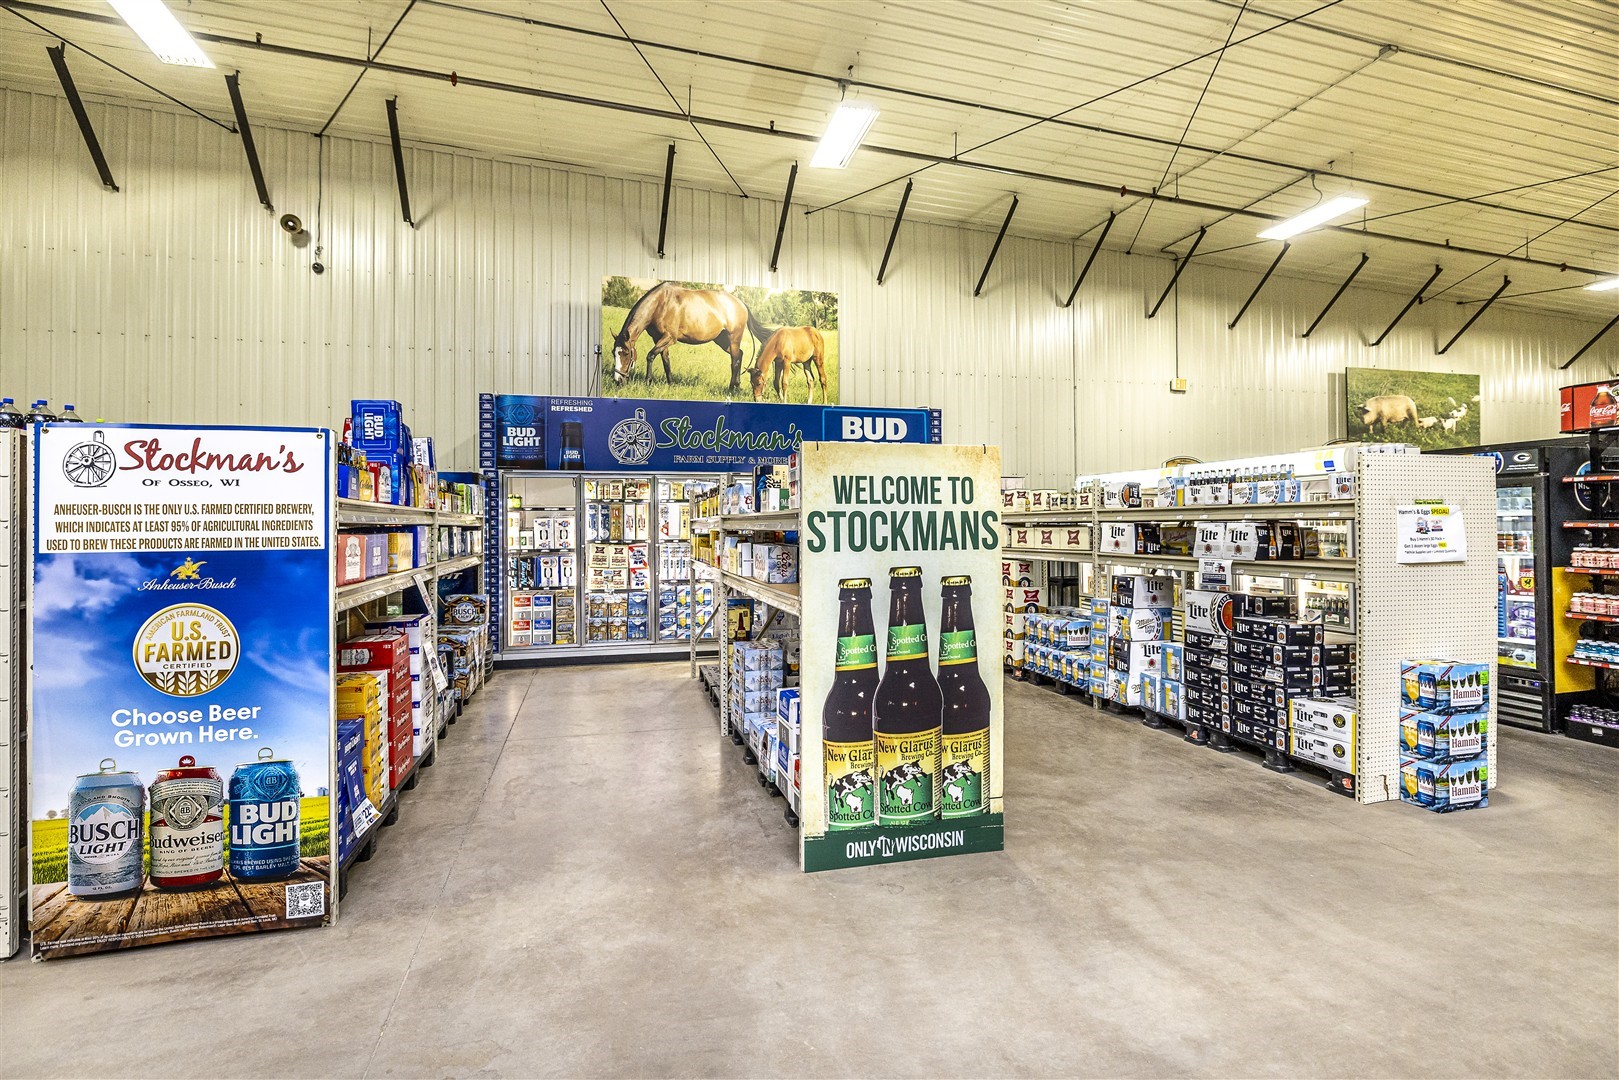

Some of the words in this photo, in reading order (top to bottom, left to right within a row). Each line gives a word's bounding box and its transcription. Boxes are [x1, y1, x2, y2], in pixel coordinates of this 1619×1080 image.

[550, 398, 593, 406] REFRESHING
[364, 412, 375, 440] LIGHT
[374, 415, 384, 438] BUD
[507, 427, 537, 437] BUD
[842, 415, 908, 440] BUD
[656, 414, 802, 452] Stockman's
[502, 436, 541, 447] LIGHT
[119, 437, 304, 475] Stockman's
[673, 455, 704, 464] FARM
[705, 455, 746, 464] SUPPLY
[747, 457, 756, 465] &
[757, 457, 789, 465] MORE
[220, 479, 240, 487] WI
[833, 475, 942, 505] WELCOME
[947, 476, 974, 505] TO
[1106, 491, 1117, 500] Lite
[1191, 488, 1201, 496] Lite
[1211, 485, 1221, 494] Lite
[54, 503, 132, 516] ANHEUSER-BUSCH
[134, 503, 142, 515] IS
[144, 503, 160, 515] THE
[162, 503, 183, 515] ONLY
[184, 503, 199, 515] U.S.
[201, 503, 232, 515] FARMED
[234, 503, 274, 515] CERTIFIED
[275, 503, 314, 516] BREWERY,
[55, 521, 84, 533] WHICH
[86, 521, 131, 533] INDICATES
[132, 521, 143, 533] AT
[144, 521, 169, 532] LEAST
[171, 520, 190, 532] 95%
[191, 520, 202, 532] OF
[203, 520, 260, 532] AGRICULTURAL
[261, 520, 313, 531] INGREDIENTS
[807, 510, 999, 553] STOCKMANS
[1111, 526, 1126, 538] Lite
[1258, 528, 1268, 536] Lite
[1282, 528, 1292, 536] Lite
[1201, 529, 1218, 542] Lite
[1230, 529, 1248, 543] Lite
[46, 539, 68, 551] USED
[70, 539, 81, 550] TO
[83, 539, 108, 551] BREW
[109, 538, 137, 550] THESE
[139, 538, 183, 550] PRODUCTS
[184, 538, 199, 549] ARE
[201, 538, 232, 549] FARMED
[234, 537, 243, 549] IN
[244, 537, 260, 548] THE
[261, 536, 290, 548] UNITED
[291, 536, 321, 548] STATES.
[1147, 543, 1161, 552] Lite
[781, 551, 791, 578] Coors
[137, 577, 237, 591] Anheuser-Busch
[1147, 580, 1163, 592] Lite
[1120, 596, 1132, 605] Lite
[453, 608, 477, 616] BUSCH
[1188, 603, 1208, 619] Lite
[146, 613, 176, 641] AMERICAN
[176, 609, 214, 623] FARMLAND
[214, 618, 231, 639] TRUST
[171, 620, 207, 642] U.S.
[1236, 621, 1250, 633] Lite
[891, 634, 919, 646] Spotted
[1186, 633, 1199, 643] Lite
[144, 640, 231, 663] FARMED
[841, 646, 868, 658] Spotted
[943, 641, 969, 651] Spotted
[1143, 644, 1161, 657] Lite
[1234, 642, 1248, 653] Lite
[1185, 651, 1198, 662] Lite
[162, 662, 212, 670] CERTIFIED
[1116, 661, 1128, 671] Lite
[1233, 662, 1248, 674] Lite
[1186, 670, 1199, 681] Lite
[1234, 682, 1248, 694] Lite
[1452, 688, 1481, 700] Hamm's
[1188, 690, 1200, 701] Lite
[1188, 707, 1200, 718] Lite
[1237, 703, 1251, 715] Lite
[111, 707, 203, 727] Choose
[209, 704, 262, 722] Beer
[1296, 709, 1313, 722] Lite
[1236, 722, 1250, 734] Lite
[114, 728, 193, 748] Grown
[199, 725, 259, 743] Here.
[1451, 737, 1480, 748] Hamm's
[878, 740, 897, 754] New
[899, 739, 934, 754] Glarus
[950, 739, 983, 753] Glarus
[1296, 738, 1314, 751] Lite
[827, 748, 846, 762] New
[848, 748, 873, 762] Glar
[900, 752, 925, 761] Brewing
[951, 752, 974, 761] Brewing
[850, 761, 874, 769] Brewing
[1451, 784, 1480, 796] Hamm's
[879, 803, 911, 816] Spotted
[913, 801, 933, 812] Cow
[941, 804, 965, 812] otted
[967, 800, 982, 810] Cow
[239, 801, 297, 825] BUD
[829, 810, 861, 823] Spotted
[863, 809, 875, 819] Co
[69, 820, 139, 844] BUSCH
[231, 820, 299, 845] LIGHT
[150, 831, 224, 849] Budweiser
[846, 840, 877, 859] ONLY
[895, 829, 965, 853] WISCONSIN
[79, 841, 127, 855] LIGHT
